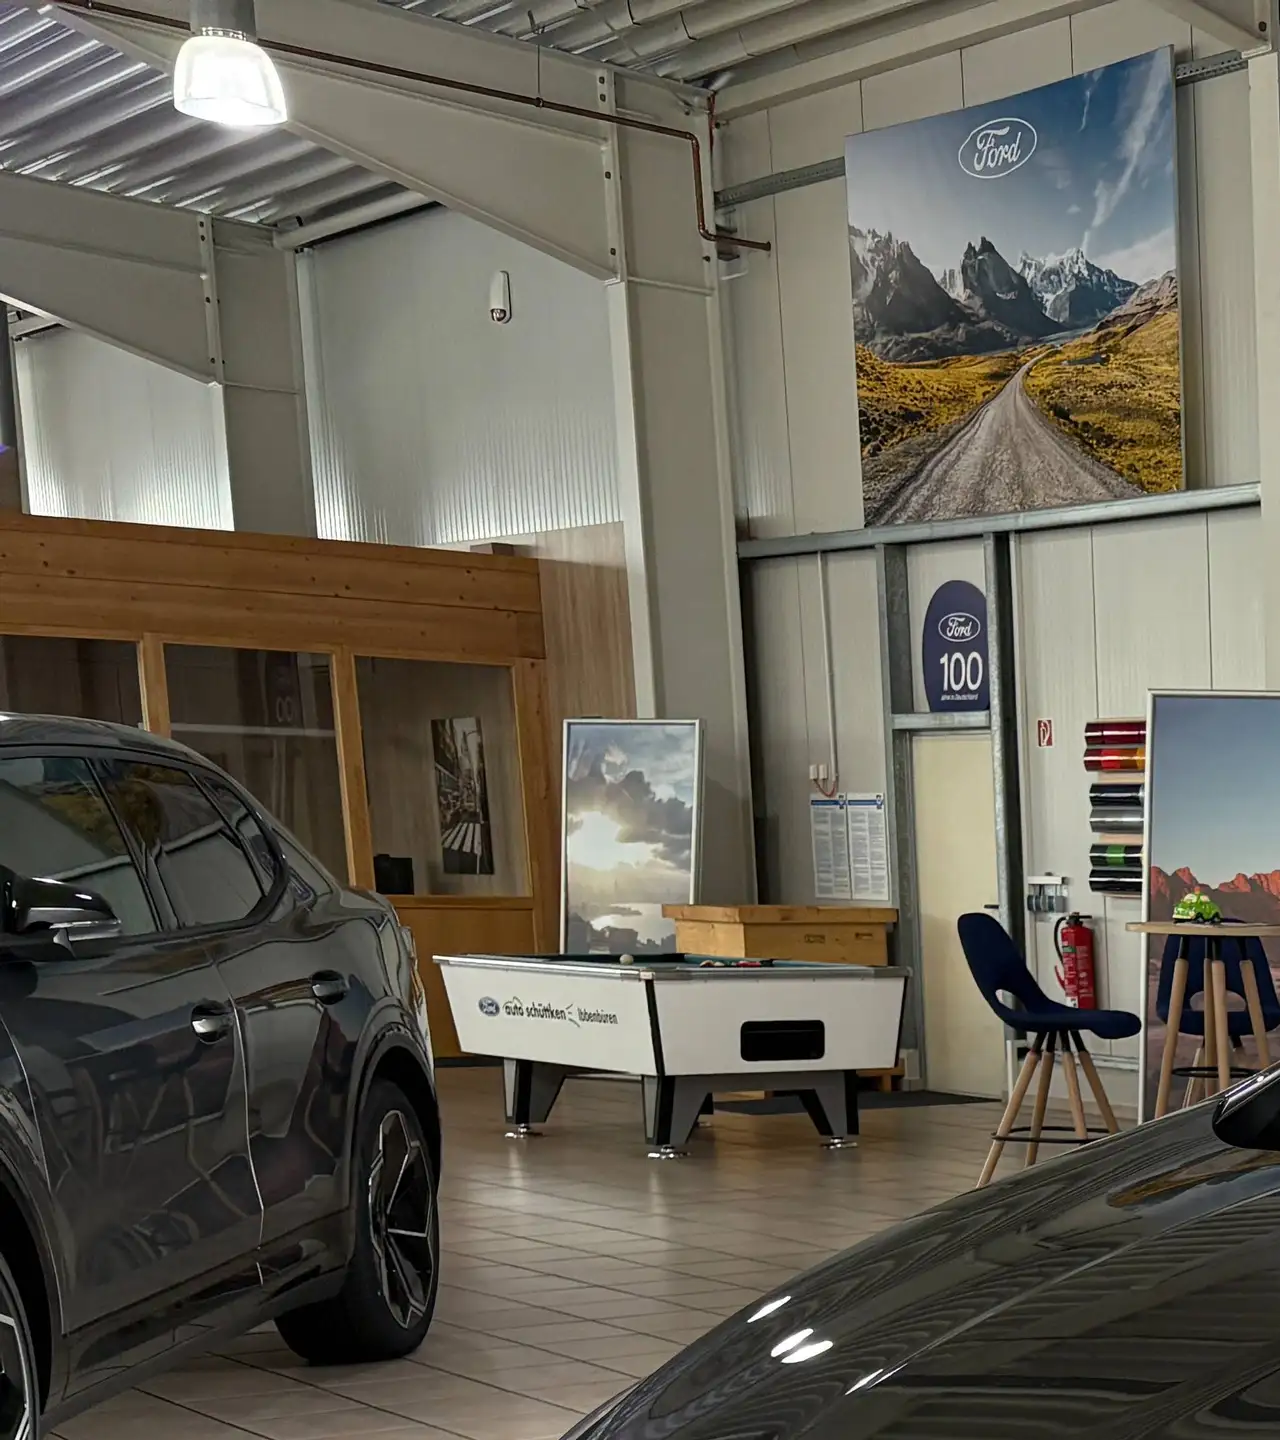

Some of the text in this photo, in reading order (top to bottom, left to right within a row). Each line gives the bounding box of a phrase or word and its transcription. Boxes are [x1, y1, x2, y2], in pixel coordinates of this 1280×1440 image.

[973, 126, 1021, 171] Ford
[946, 616, 972, 637] Ford
[940, 651, 983, 691] 100
[504, 1002, 524, 1016] auto
[525, 1001, 567, 1020] schüttken
